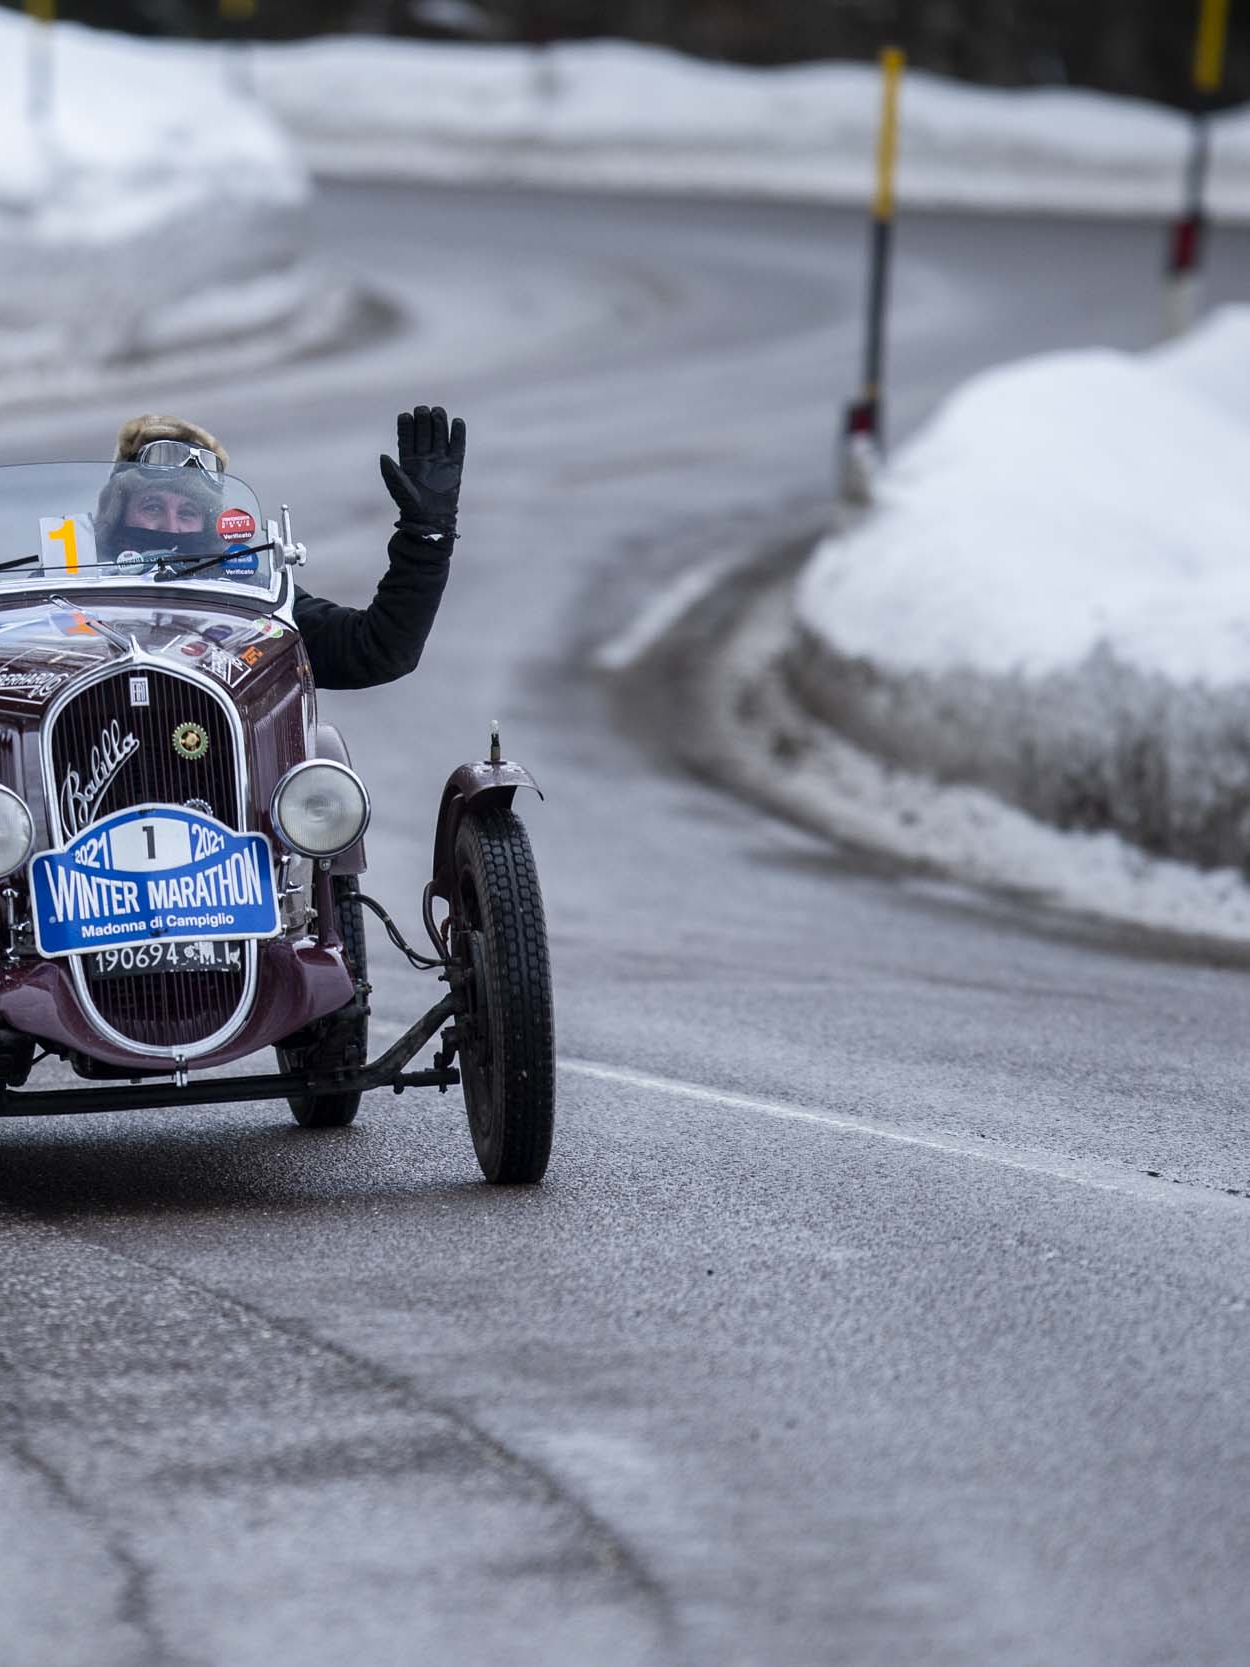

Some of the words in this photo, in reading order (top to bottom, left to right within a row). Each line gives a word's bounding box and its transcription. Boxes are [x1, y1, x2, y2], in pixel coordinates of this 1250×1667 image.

[48, 519, 79, 574] 1
[61, 719, 140, 839] Balilla
[74, 831, 110, 870] 2021
[142, 825, 156, 859] 1
[191, 823, 225, 862] 2021
[44, 860, 140, 922] WINTER
[147, 841, 262, 910] MARATHON
[81, 920, 147, 938] Madonna
[150, 915, 163, 928] di
[166, 912, 235, 928] Campiglio
[95, 942, 179, 973] 190694
